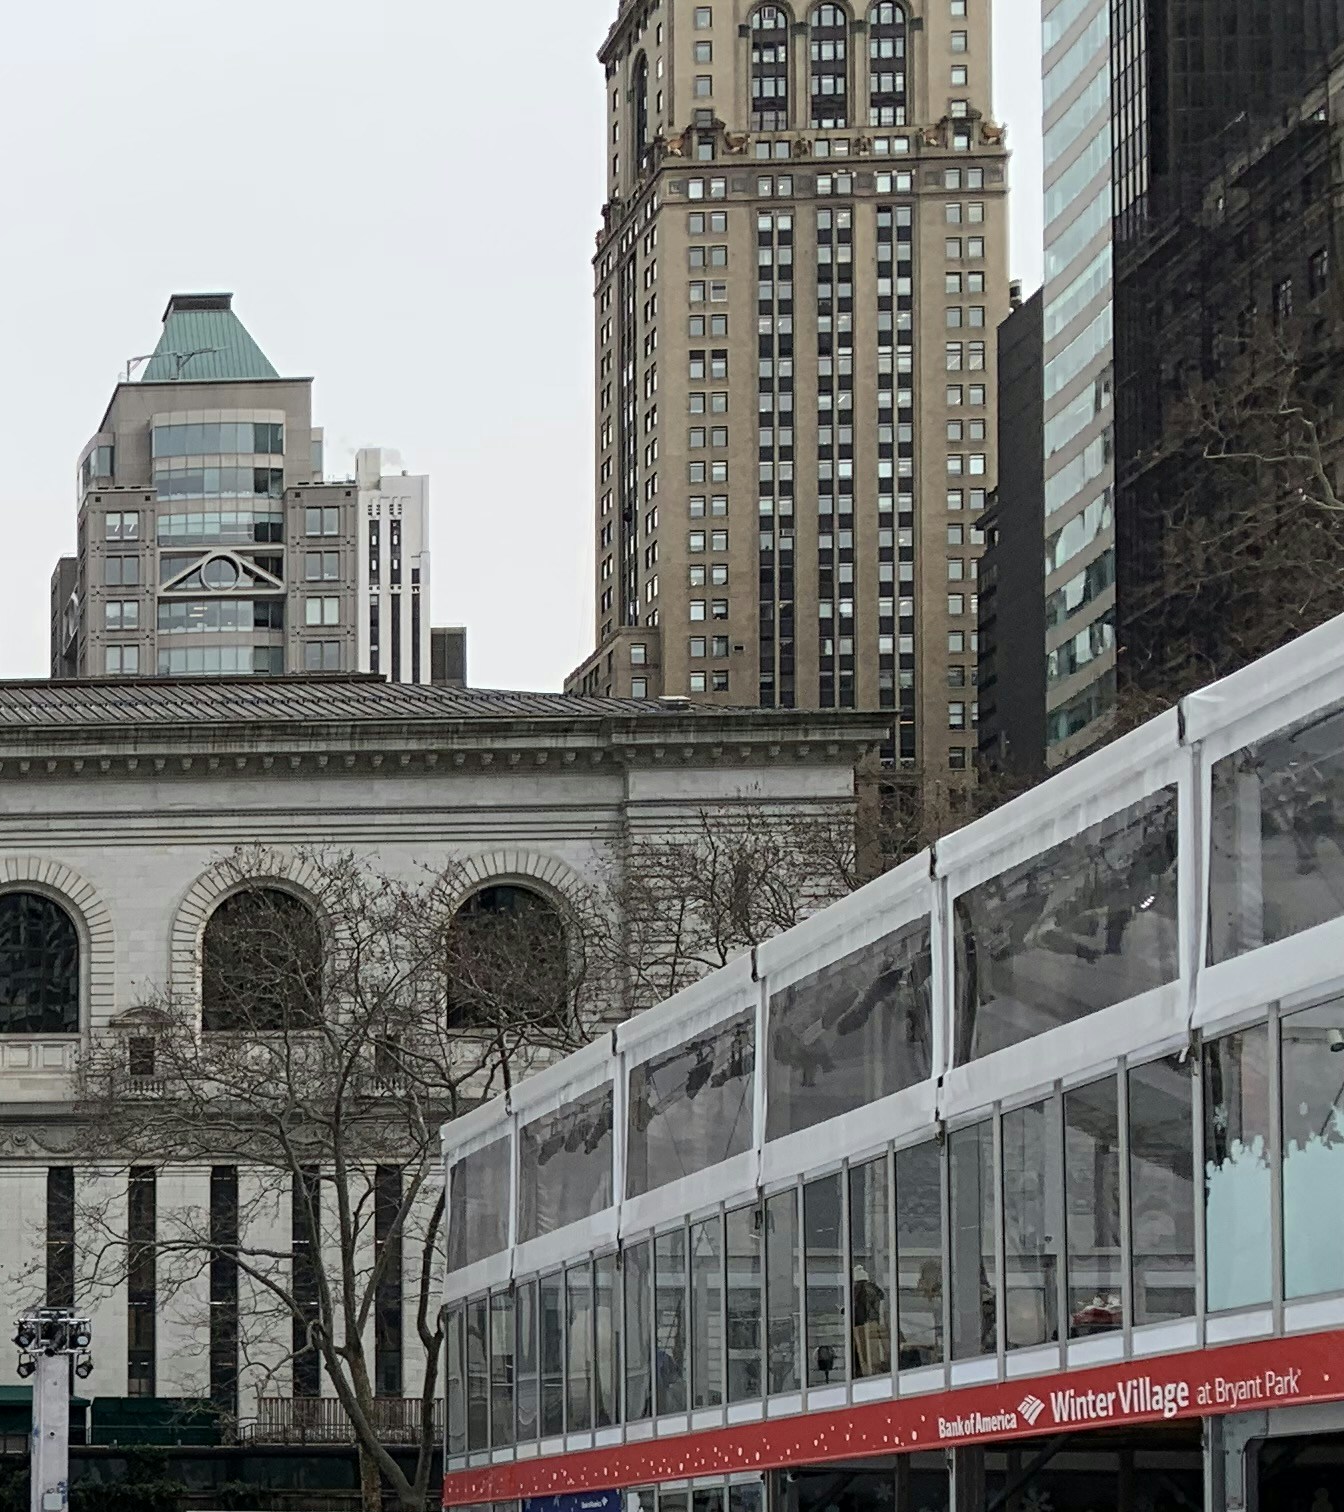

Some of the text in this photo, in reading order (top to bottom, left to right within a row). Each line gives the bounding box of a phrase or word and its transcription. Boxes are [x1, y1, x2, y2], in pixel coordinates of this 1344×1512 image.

[1050, 1376, 1189, 1423] Winter Village
[1197, 1367, 1300, 1408] at Bryant Park
[938, 1409, 1017, 1439] Bank of America
